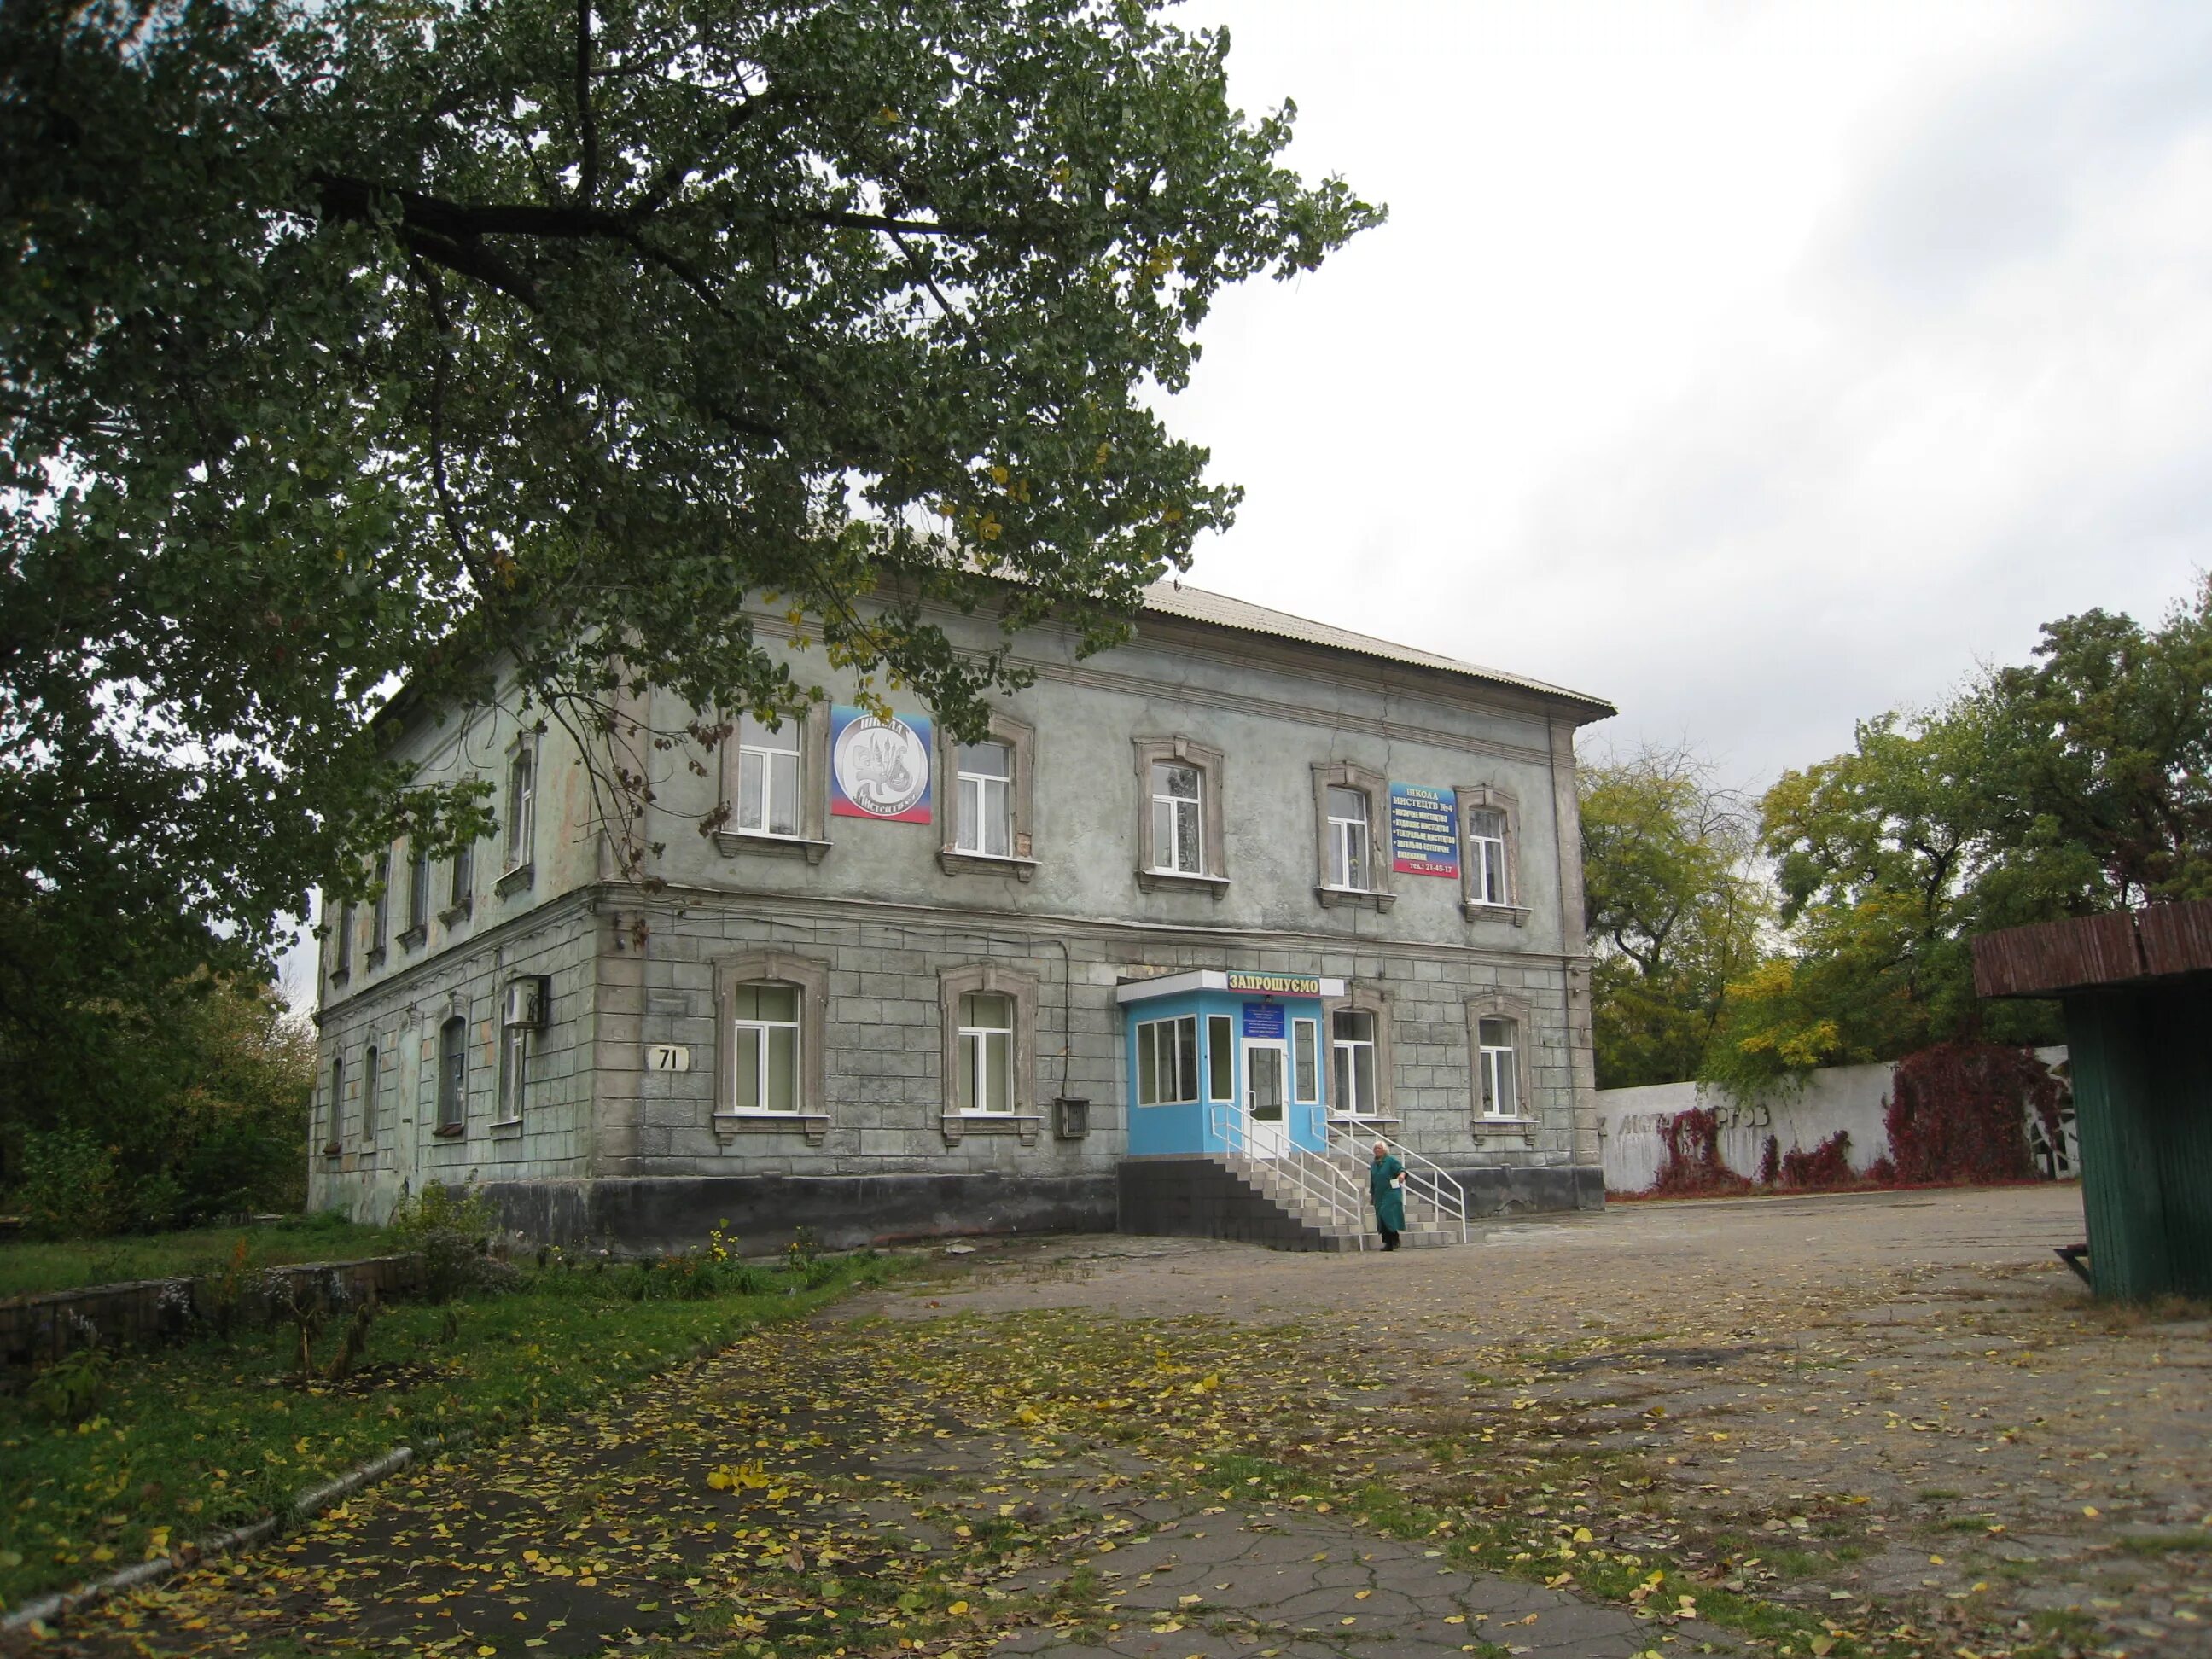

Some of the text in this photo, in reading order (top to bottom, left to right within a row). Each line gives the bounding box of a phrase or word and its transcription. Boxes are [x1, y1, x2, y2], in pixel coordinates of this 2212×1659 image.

[1406, 789, 1438, 800] ШКОЛА
[1393, 796, 1438, 809] МИСТЕЦТВ
[1230, 975, 1318, 993] ЗАПРОШУЄМО
[659, 1049, 677, 1069] 71
